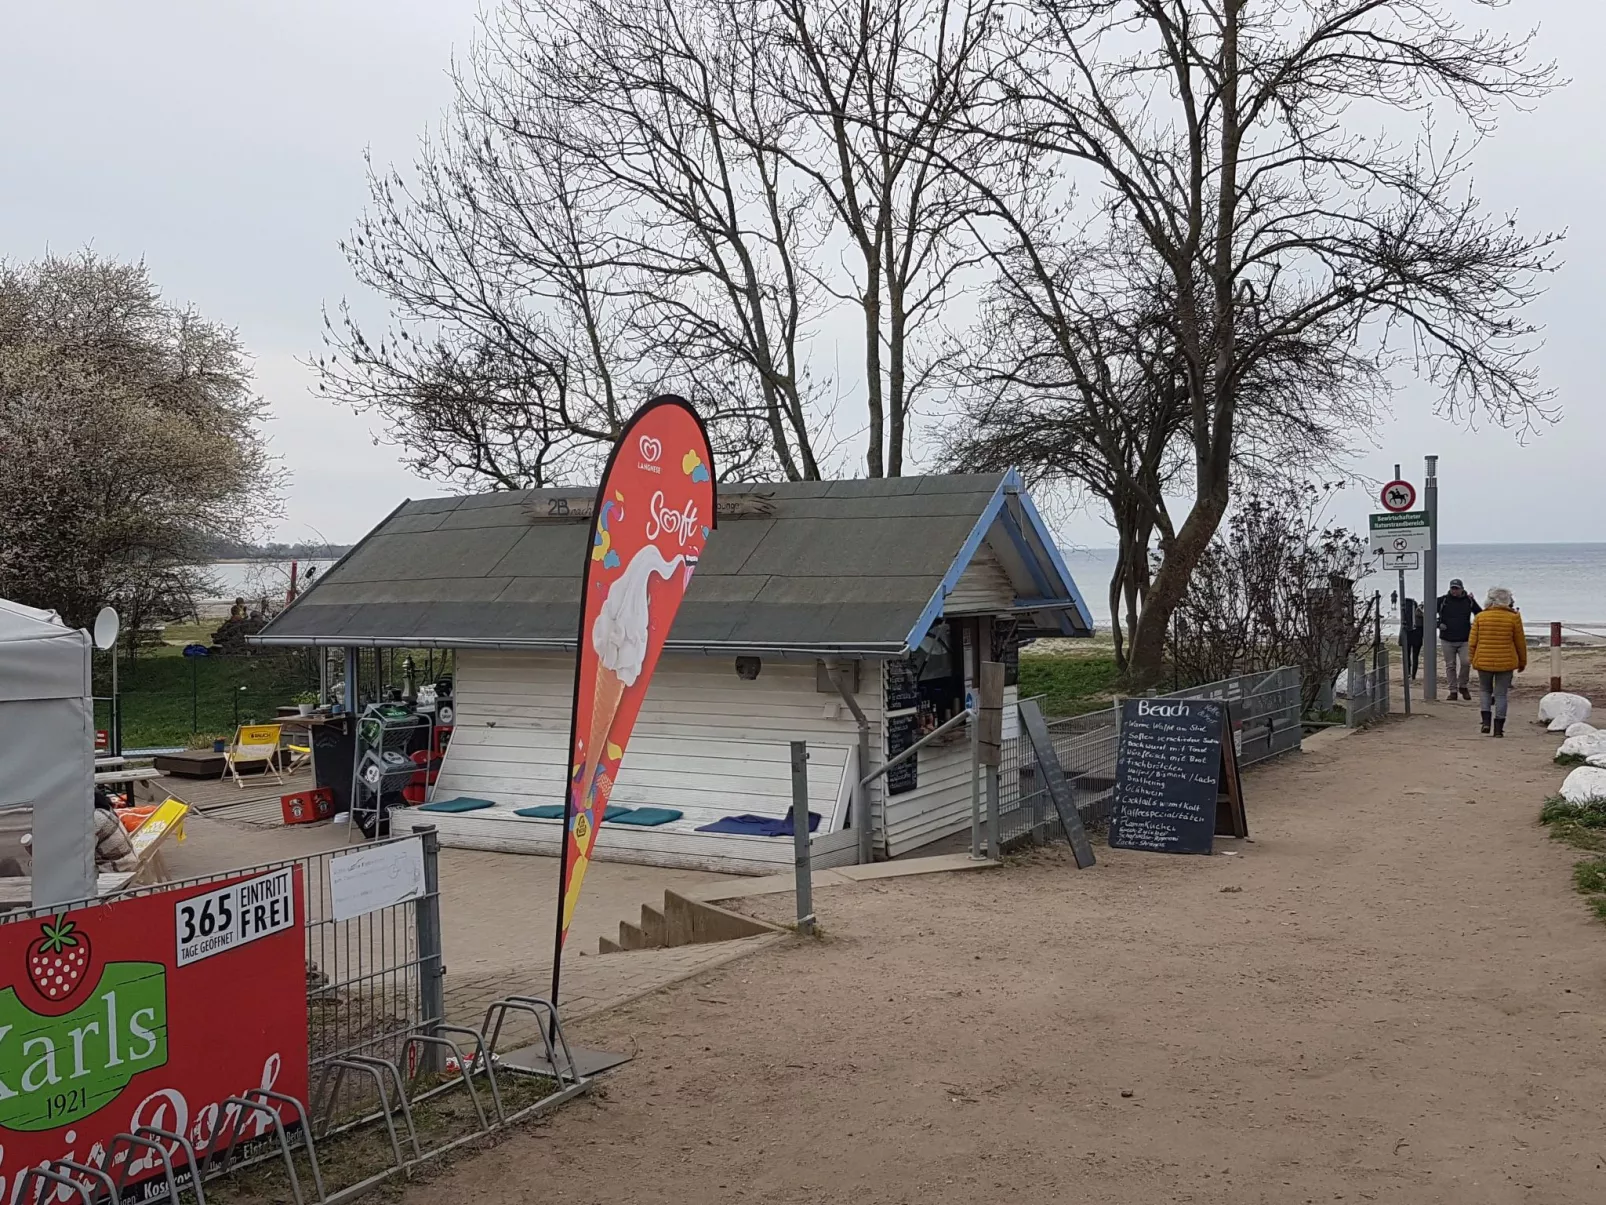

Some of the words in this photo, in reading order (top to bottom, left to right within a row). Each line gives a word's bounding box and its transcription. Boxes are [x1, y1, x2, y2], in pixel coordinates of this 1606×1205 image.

[637, 461, 661, 475] LANGNESE
[646, 490, 698, 546] Soft
[1374, 520, 1425, 529] Naturstrandbereich
[1377, 514, 1421, 522] Bewirtschafteter
[1138, 700, 1189, 717] Beach
[1169, 744, 1185, 752] mit
[1125, 783, 1164, 797] Glühwein
[240, 872, 289, 908] EINTRITT
[181, 892, 232, 944] 365
[241, 895, 289, 939] FREI
[181, 943, 199, 960] TAGE
[200, 931, 234, 953] GEÖFFNET
[47, 1087, 87, 1119] 1921
